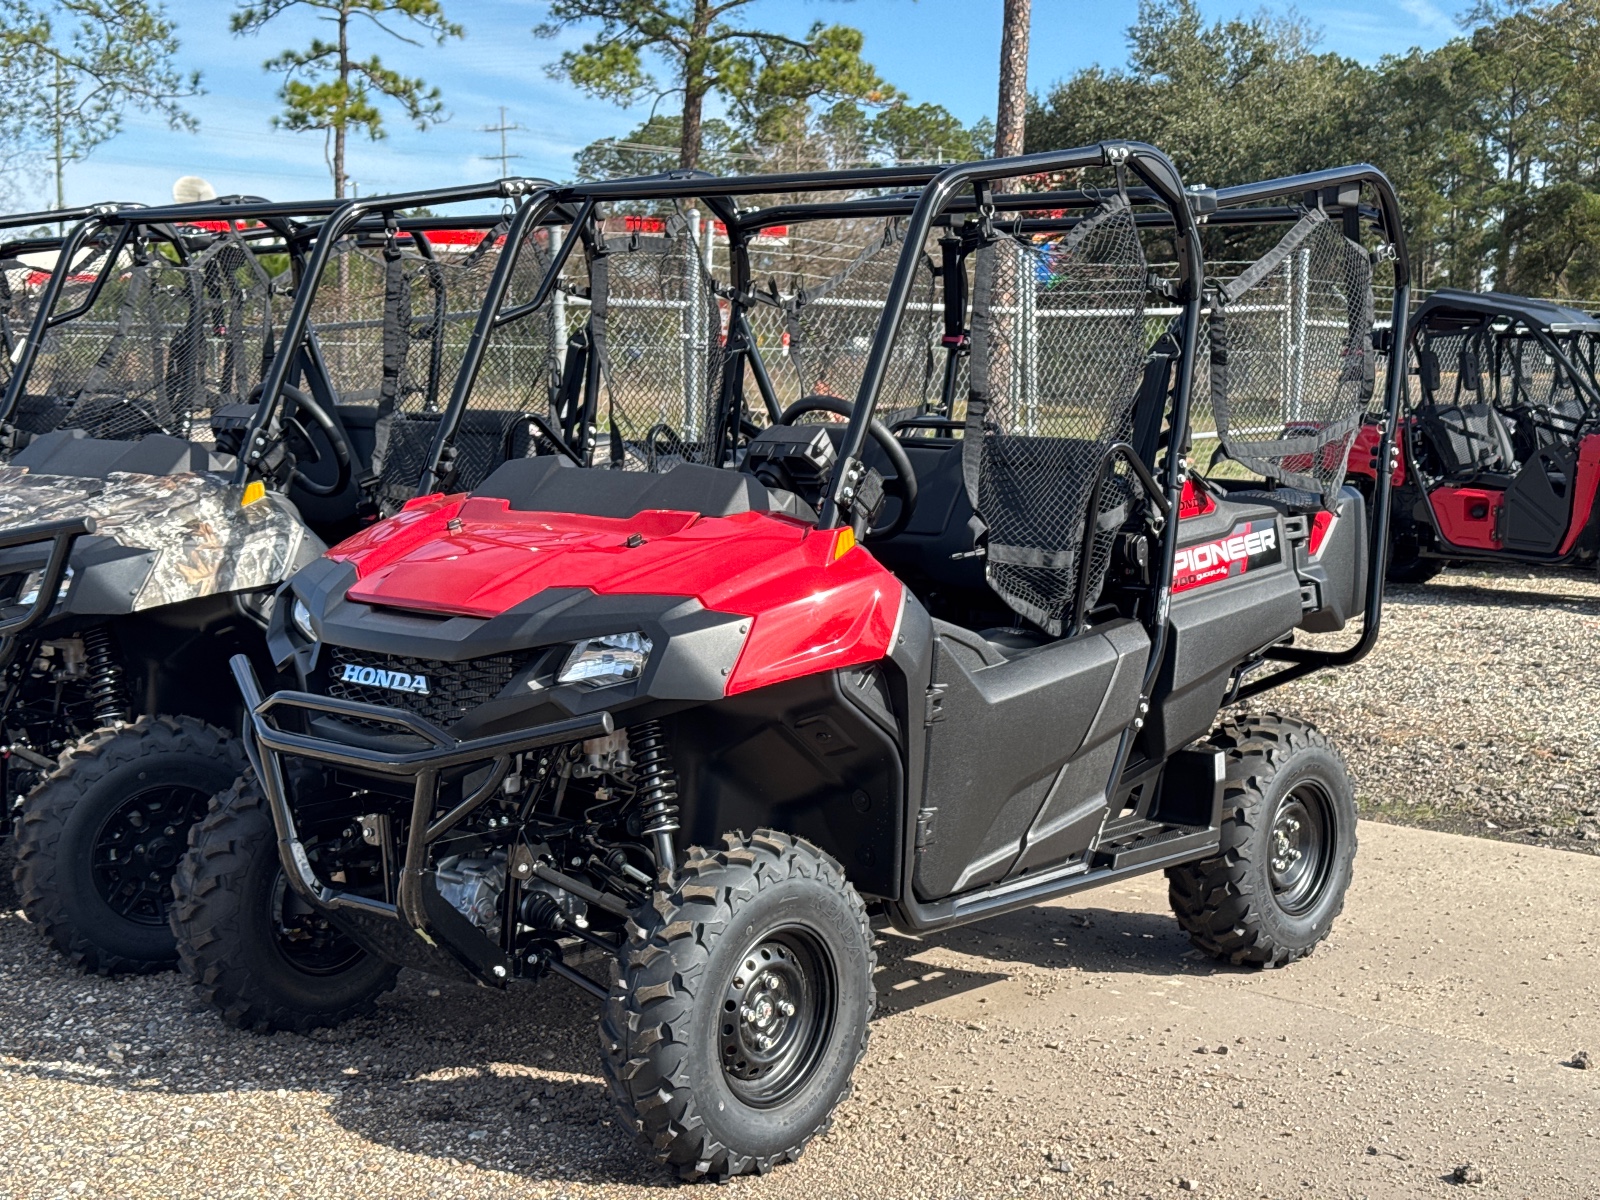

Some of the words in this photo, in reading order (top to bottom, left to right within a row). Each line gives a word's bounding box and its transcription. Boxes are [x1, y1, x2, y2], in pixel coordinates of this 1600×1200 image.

[1173, 527, 1277, 578] PIONEER
[1173, 574, 1197, 588] 700
[340, 664, 430, 695] HONDA
[810, 893, 861, 963] KENDA
